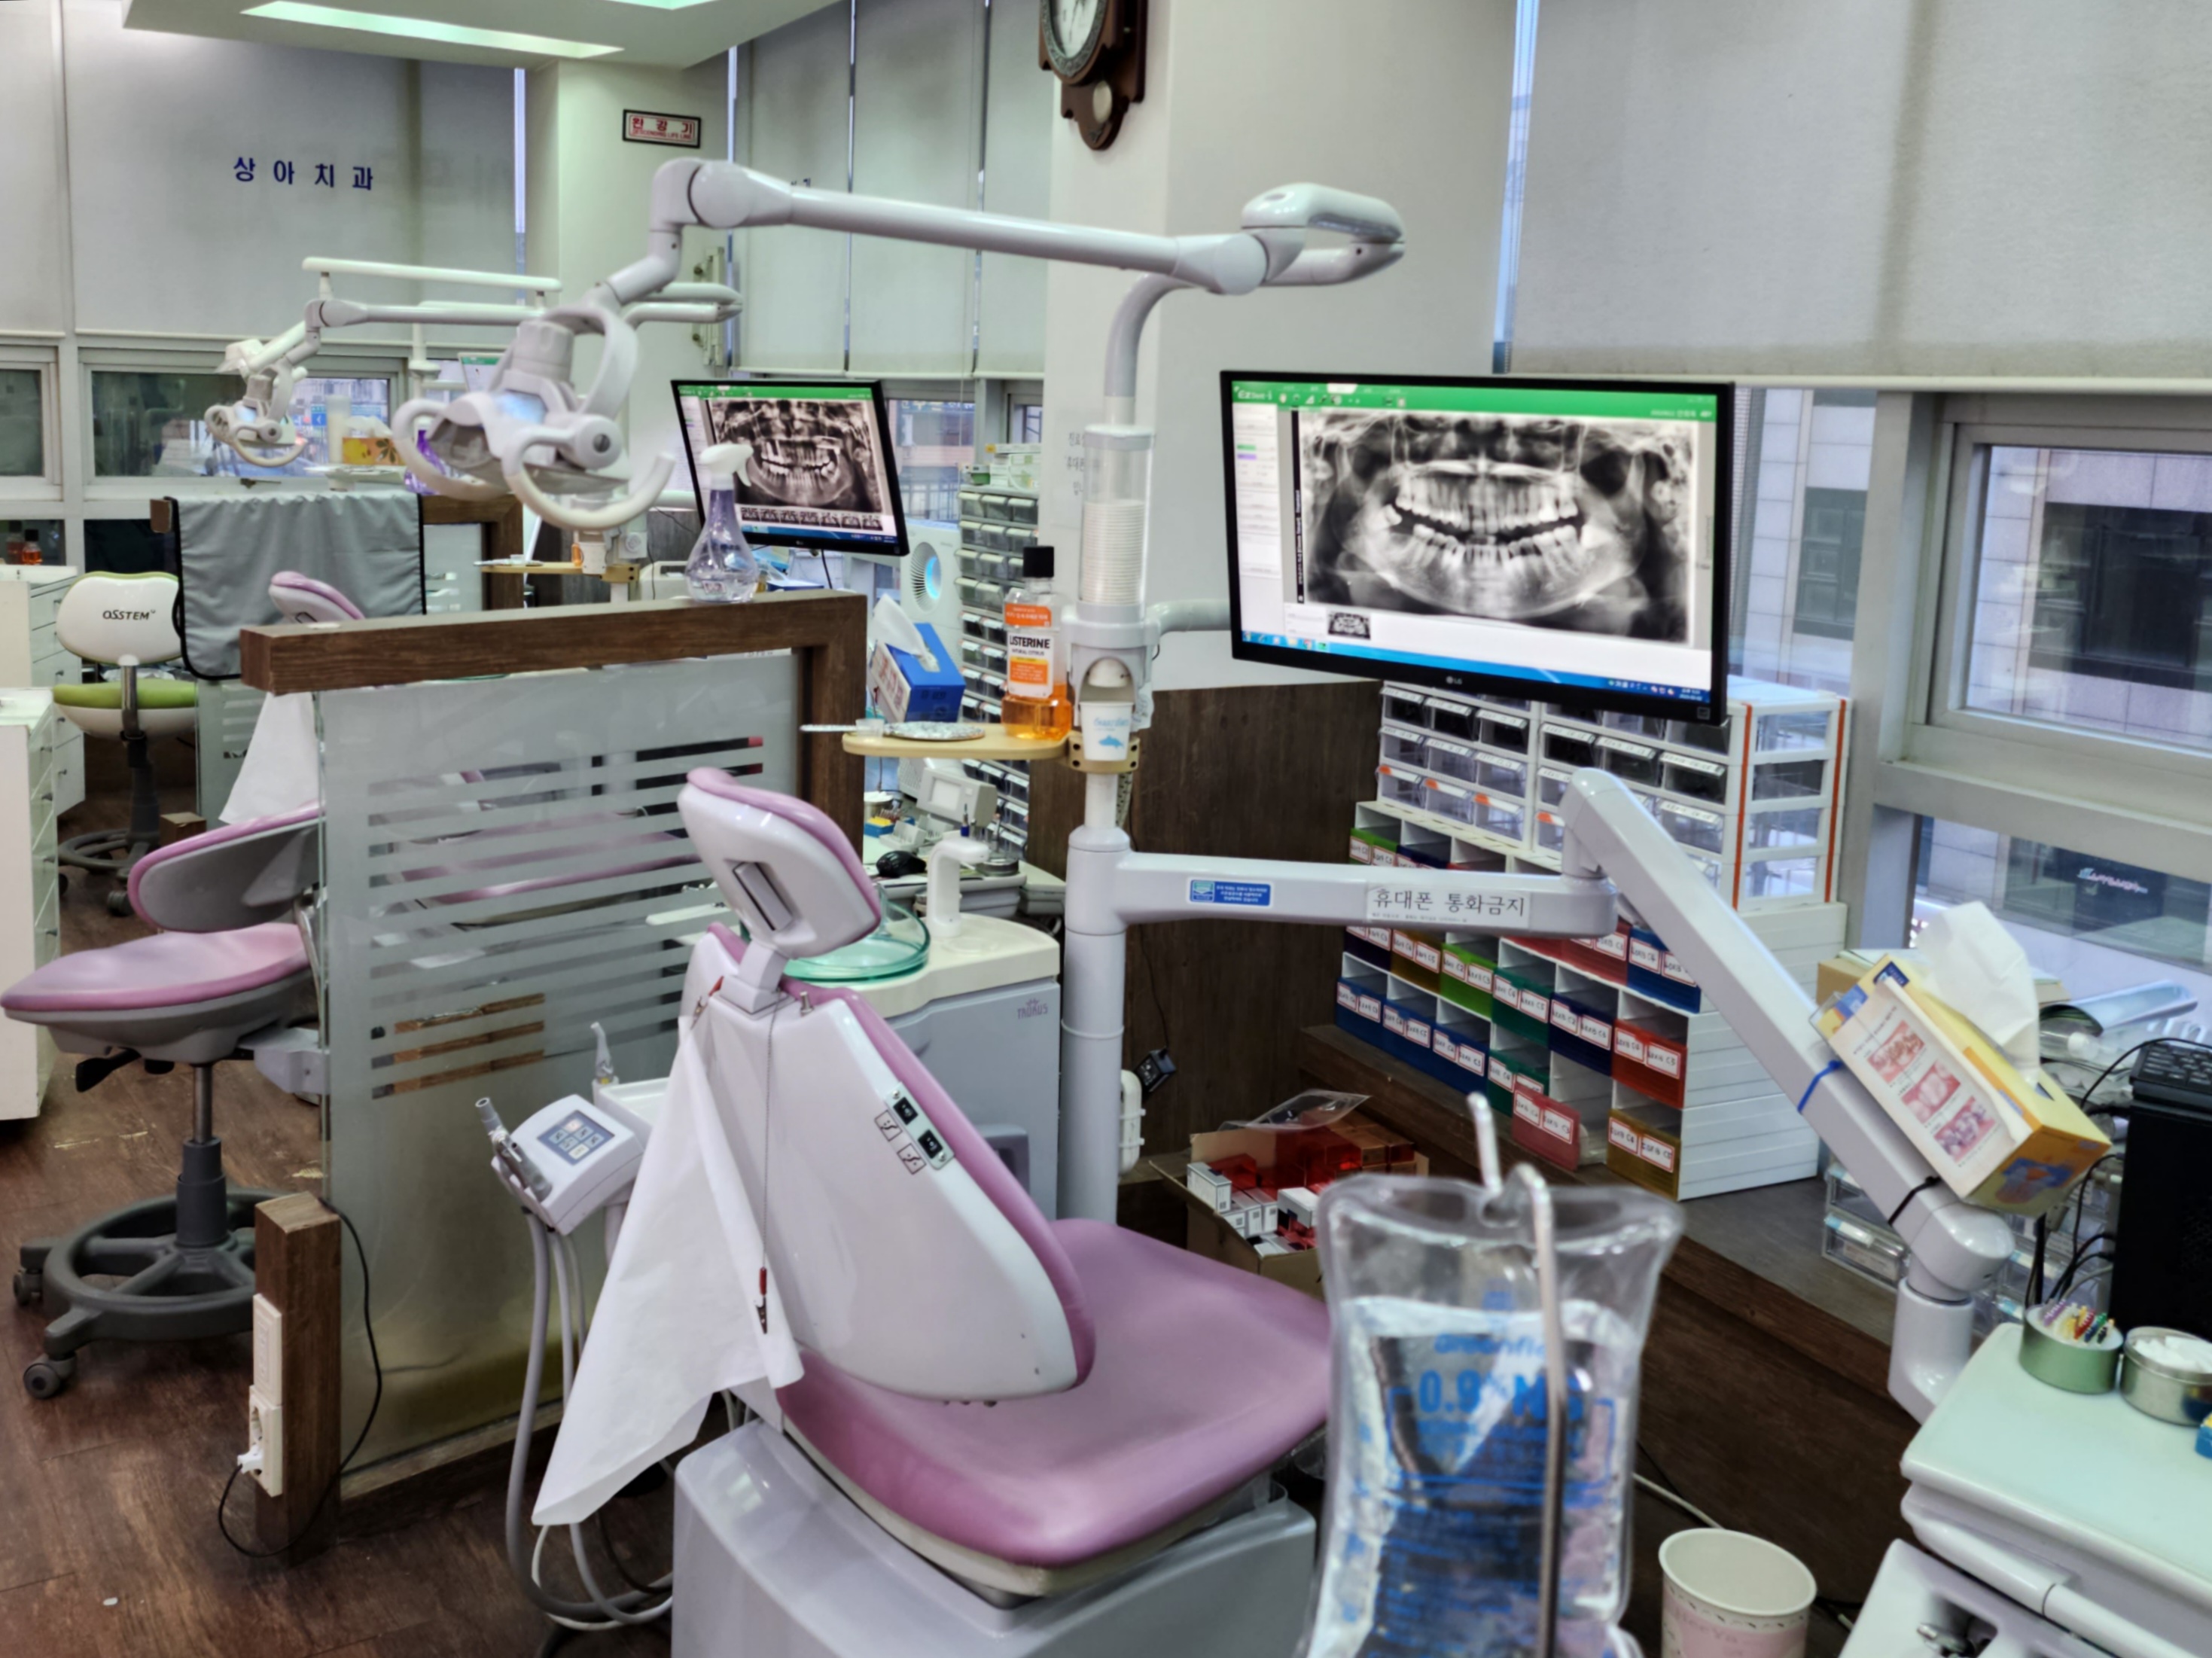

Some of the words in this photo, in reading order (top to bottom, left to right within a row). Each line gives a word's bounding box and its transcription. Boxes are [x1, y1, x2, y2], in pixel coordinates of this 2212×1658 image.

[102, 610, 150, 620] OSSTEM
[1009, 635, 1050, 649] LISTERINE
[1373, 888, 1434, 911] 휴대폰
[1444, 893, 1525, 917] 통화금지
